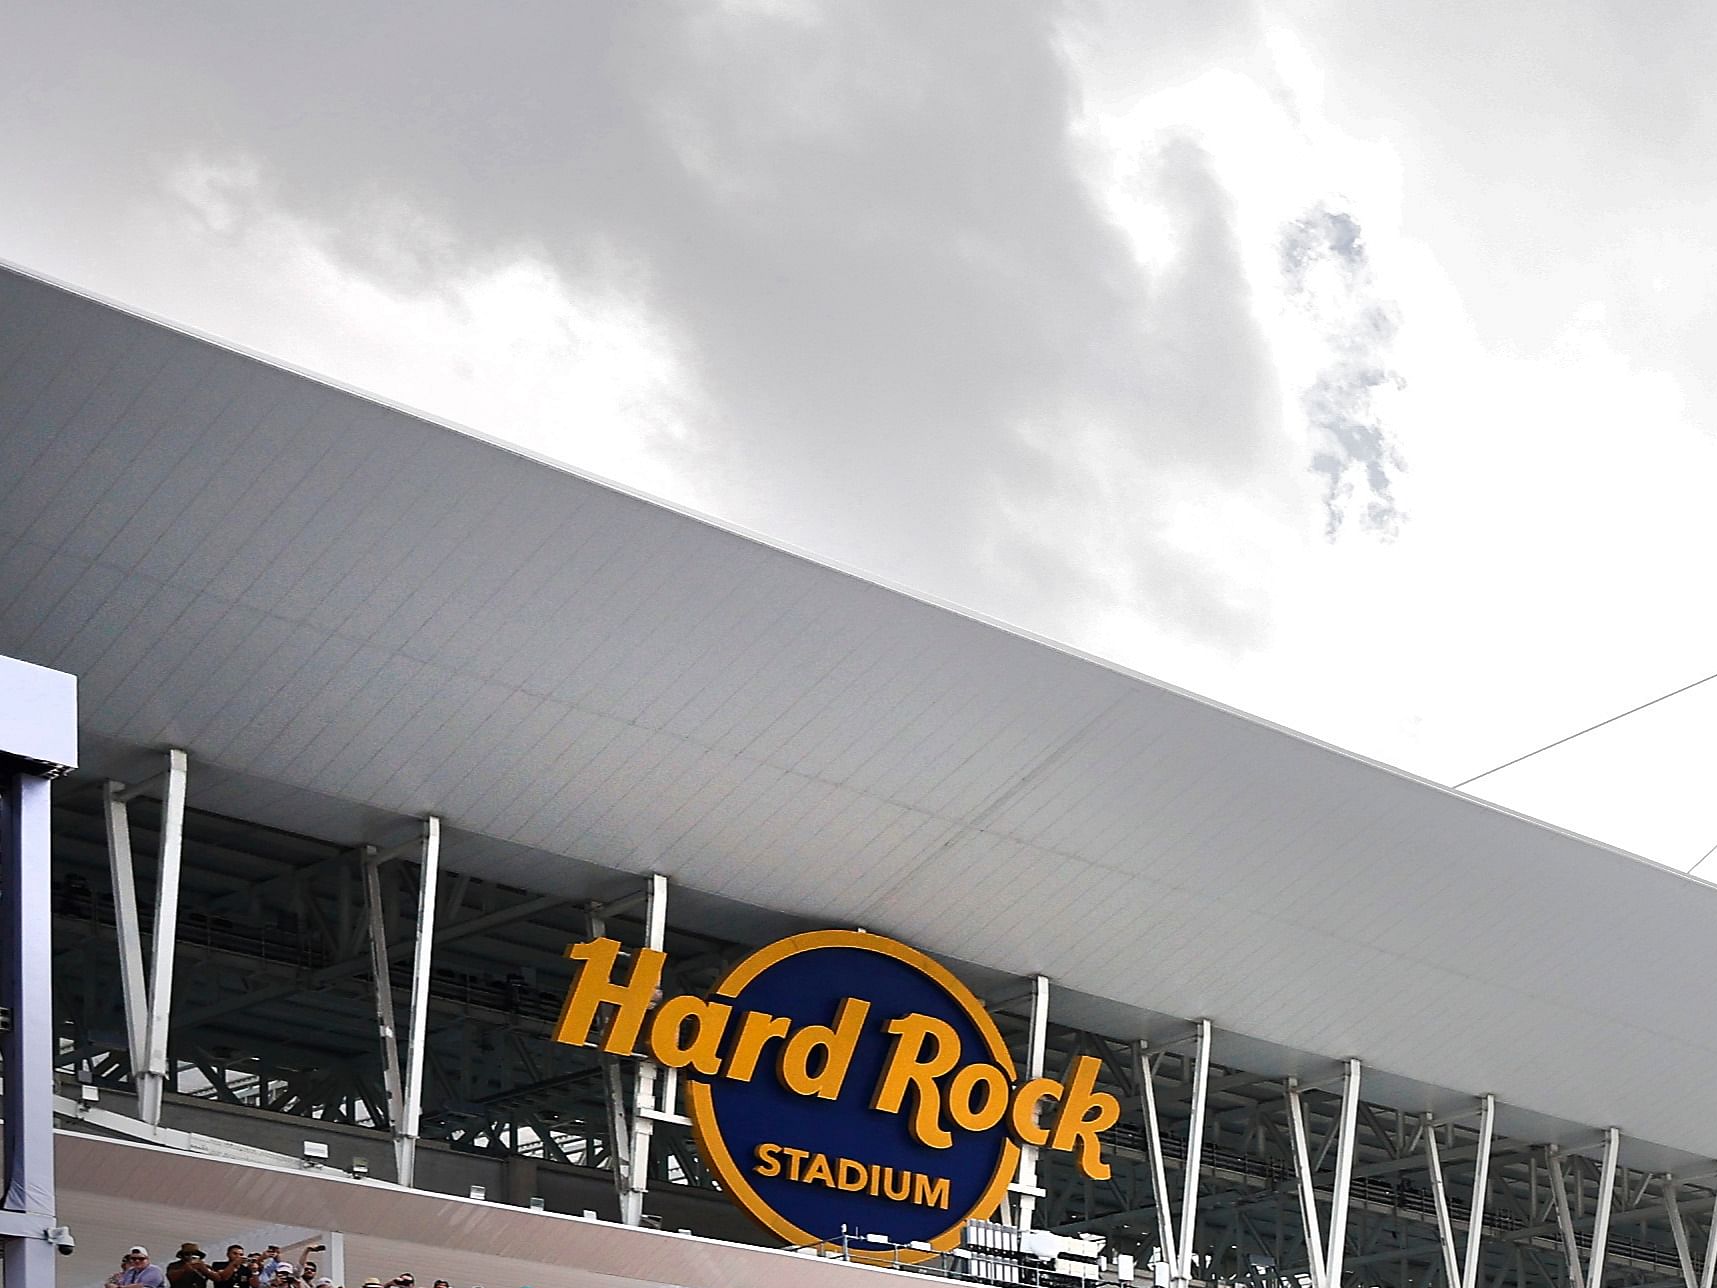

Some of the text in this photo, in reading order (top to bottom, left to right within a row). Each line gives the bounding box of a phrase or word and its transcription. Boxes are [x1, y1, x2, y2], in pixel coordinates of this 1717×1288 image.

[551, 936, 1121, 1181] Hard Rock
[753, 1142, 950, 1210] STADIUM
